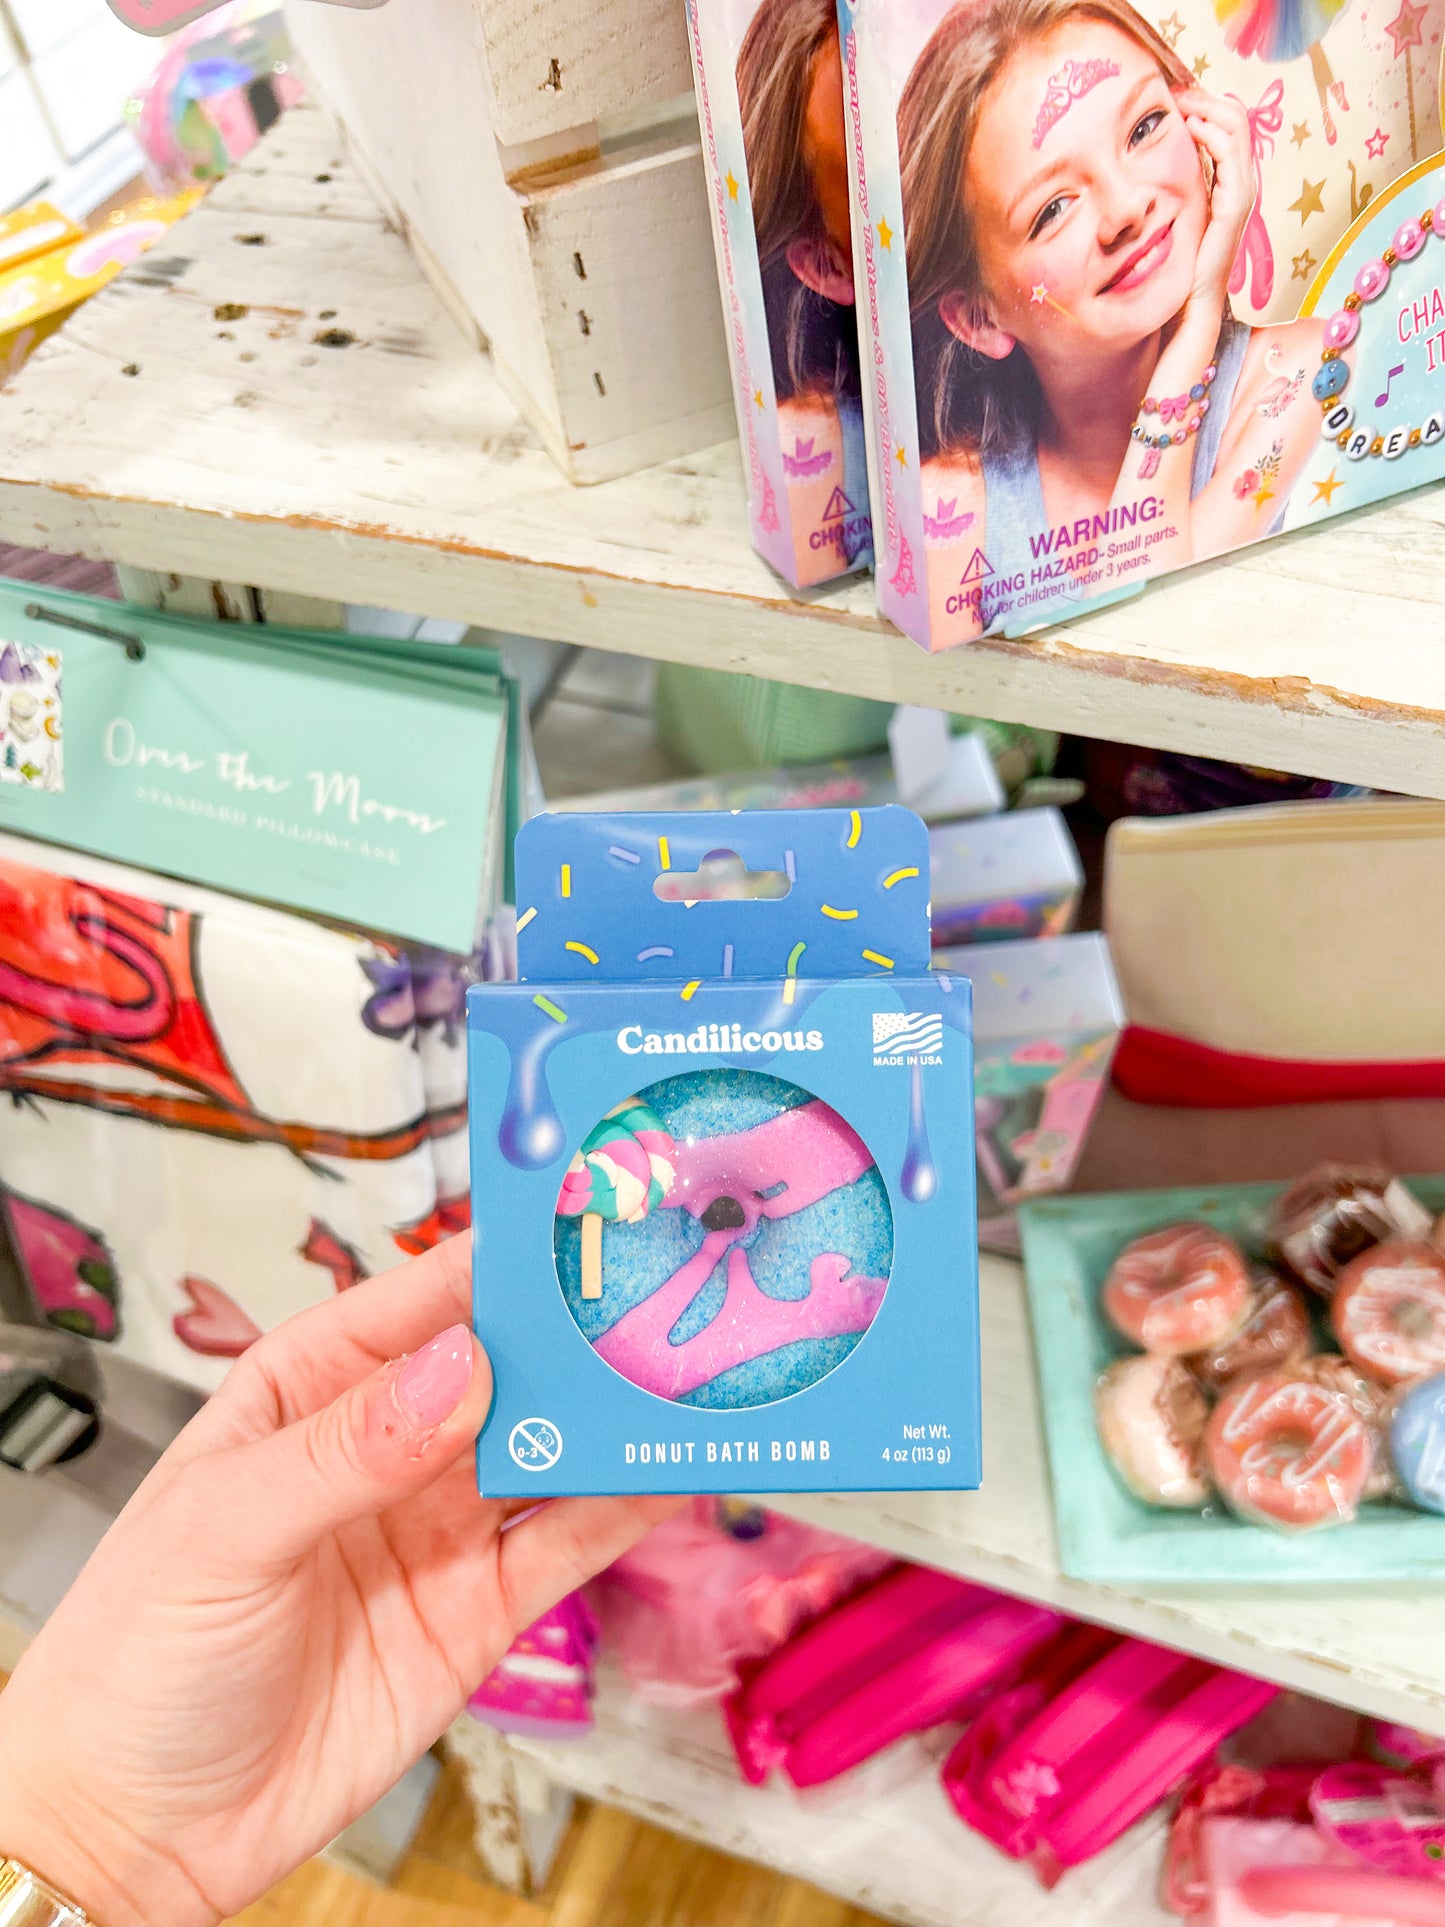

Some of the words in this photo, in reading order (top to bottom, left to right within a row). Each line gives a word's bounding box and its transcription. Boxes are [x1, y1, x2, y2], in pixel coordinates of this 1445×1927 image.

[845, 27, 870, 219] Temporary
[862, 223, 880, 338] Tattoos
[874, 340, 885, 366] &
[875, 368, 890, 427] DIY
[881, 428, 898, 552] Bracelets
[1029, 496, 1165, 559] WARNING:
[945, 573, 1026, 615] CHOKING
[1107, 534, 1142, 559] Small
[1145, 525, 1180, 548] parts.
[971, 604, 994, 624] Not
[997, 598, 1016, 616] for
[1017, 581, 1065, 609] children
[1068, 569, 1103, 593] under
[1105, 564, 1114, 578] 3
[1116, 554, 1152, 577] years.
[103, 716, 205, 775] Over
[216, 750, 293, 793] the
[306, 770, 448, 834] Moon
[134, 785, 248, 827] STANDARD
[616, 1023, 825, 1055] Candilicous
[873, 1056, 904, 1066] MADE
[906, 1055, 918, 1066] IN
[920, 1055, 943, 1066] USA
[517, 1447, 538, 1459] 0-3
[625, 1442, 695, 1464] DONUT
[706, 1441, 760, 1463] BATH
[771, 1440, 831, 1462] BOMB
[882, 1447, 891, 1462] 4
[893, 1449, 909, 1462] oz
[911, 1446, 934, 1465] (113
[937, 1446, 952, 1465] g)
[903, 1424, 926, 1440] Net
[928, 1424, 951, 1439] Wt.
